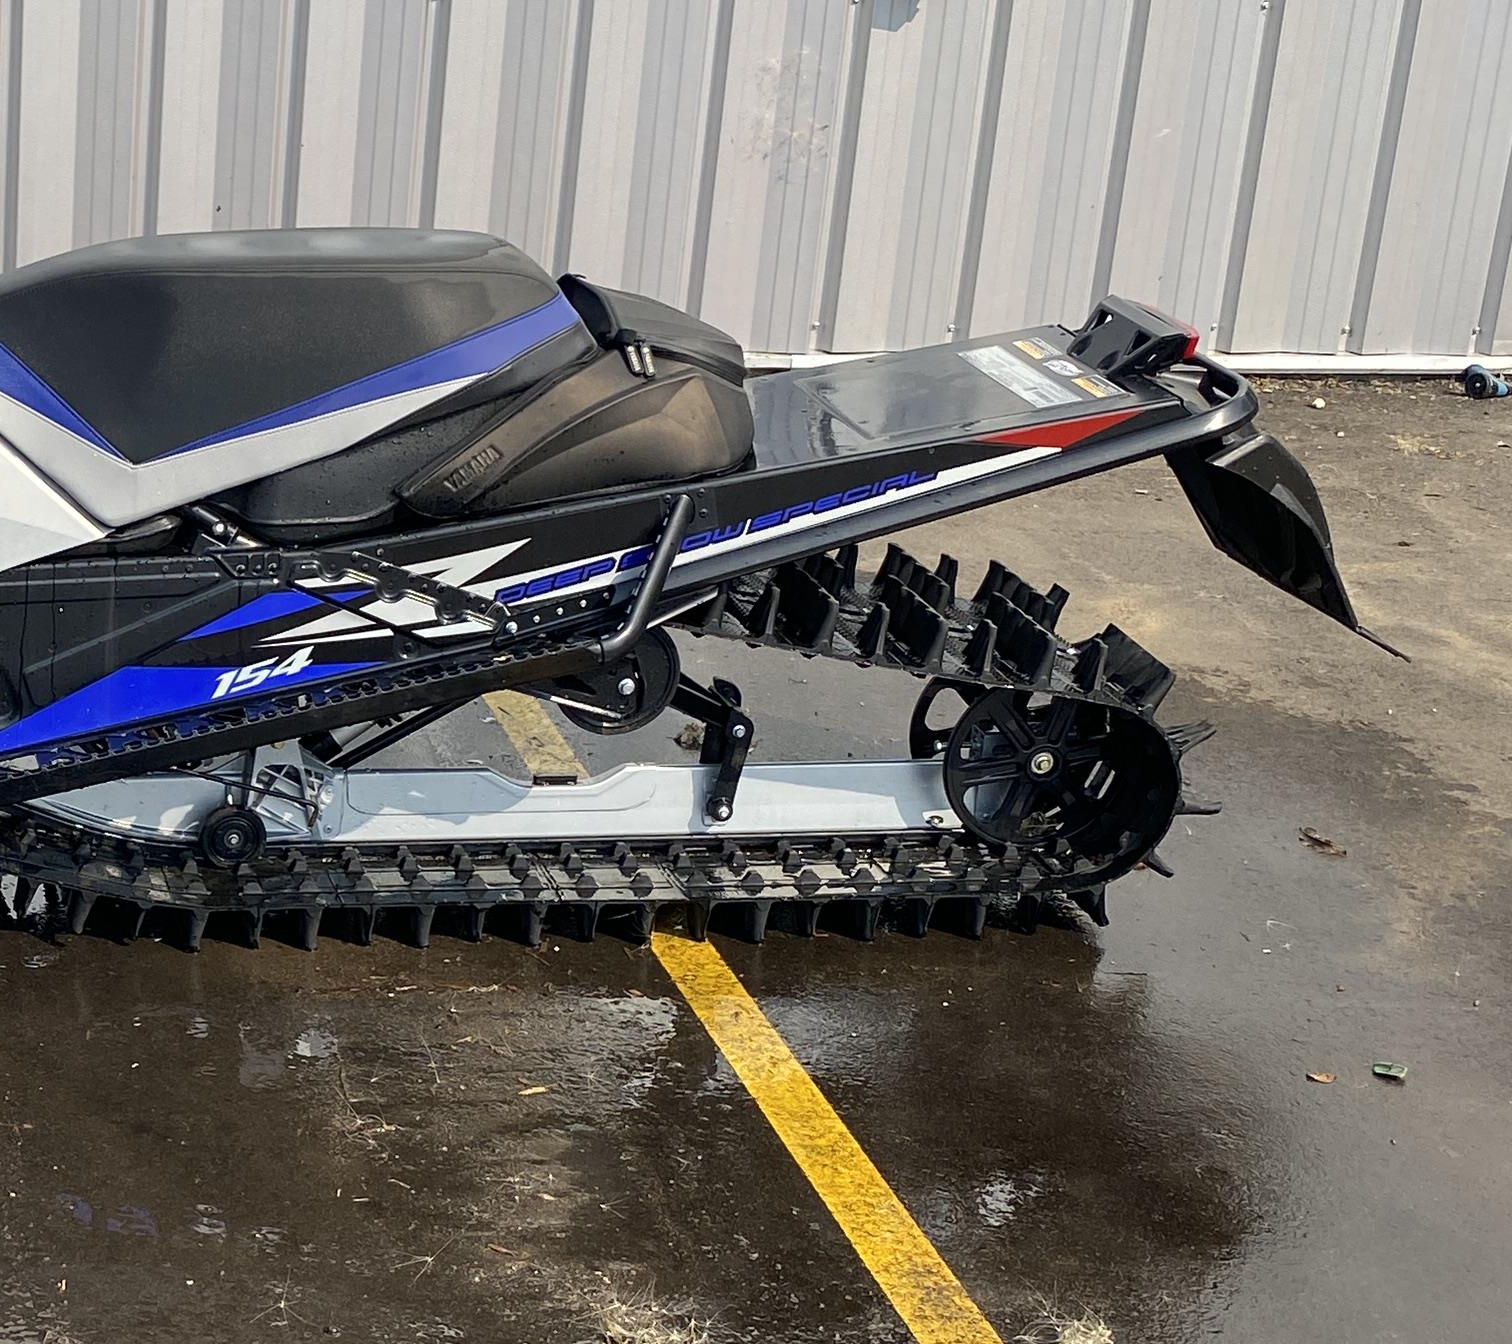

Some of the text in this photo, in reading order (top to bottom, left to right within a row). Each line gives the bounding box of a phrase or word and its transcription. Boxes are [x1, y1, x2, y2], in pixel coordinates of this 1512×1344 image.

[443, 444, 502, 492] YAMAHA
[495, 557, 617, 605] DEEP
[748, 461, 938, 534] SPECIAL
[210, 645, 315, 700] 154
